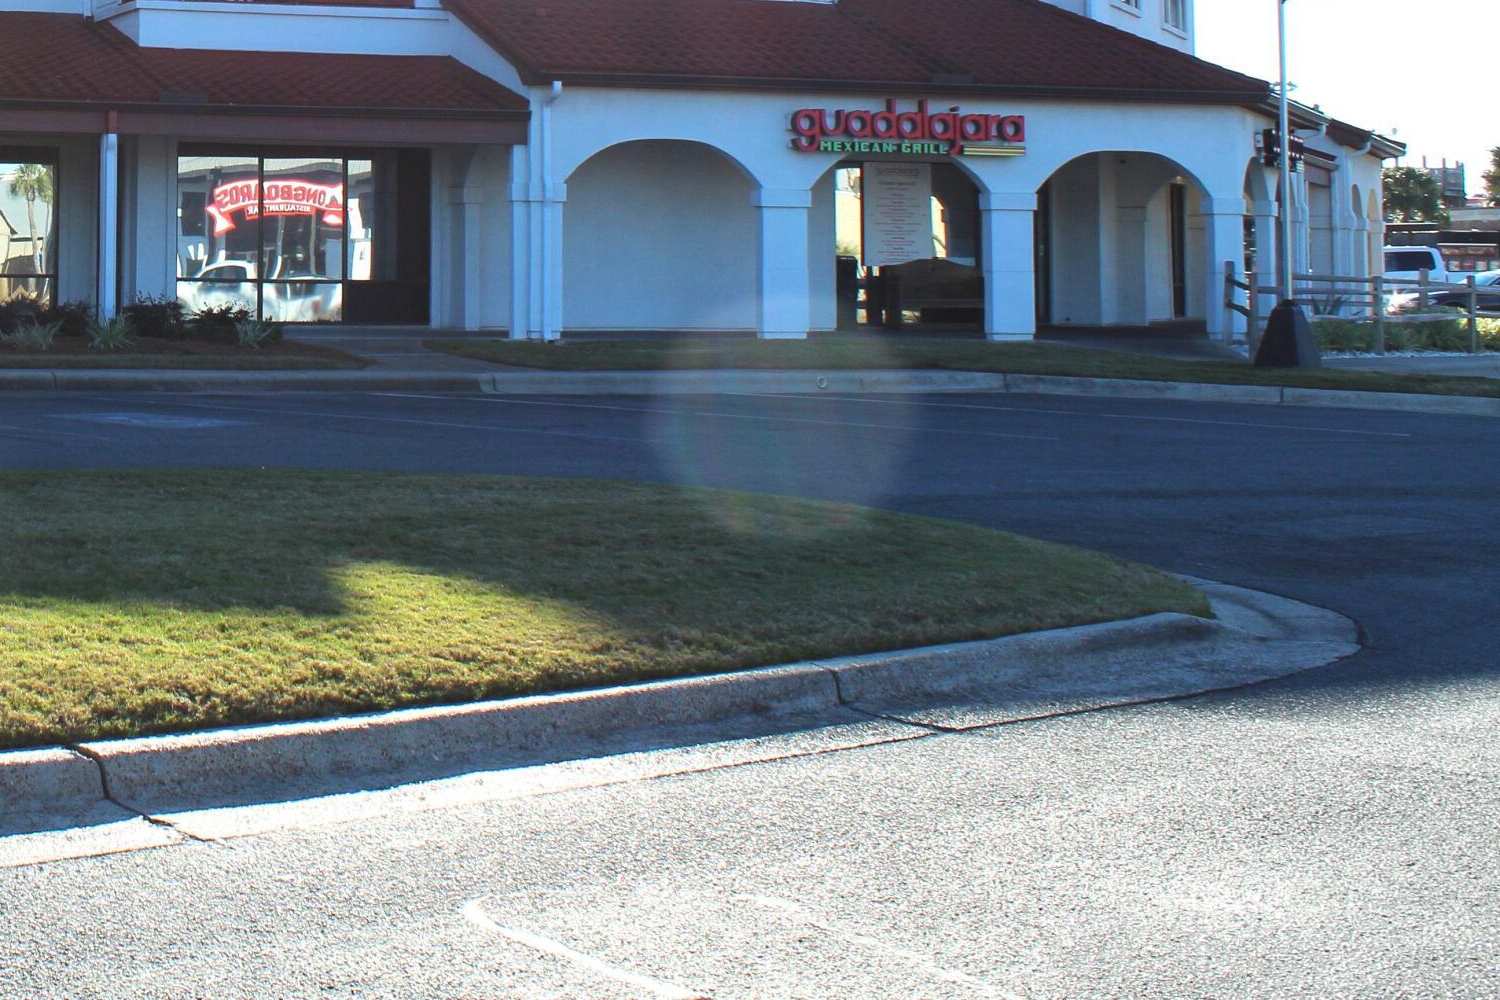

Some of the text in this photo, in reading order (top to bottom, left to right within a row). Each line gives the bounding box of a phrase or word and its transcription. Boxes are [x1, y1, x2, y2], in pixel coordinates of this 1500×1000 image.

[790, 98, 1026, 155] guadalajara
[820, 140, 948, 155] MEXICAN GRILL
